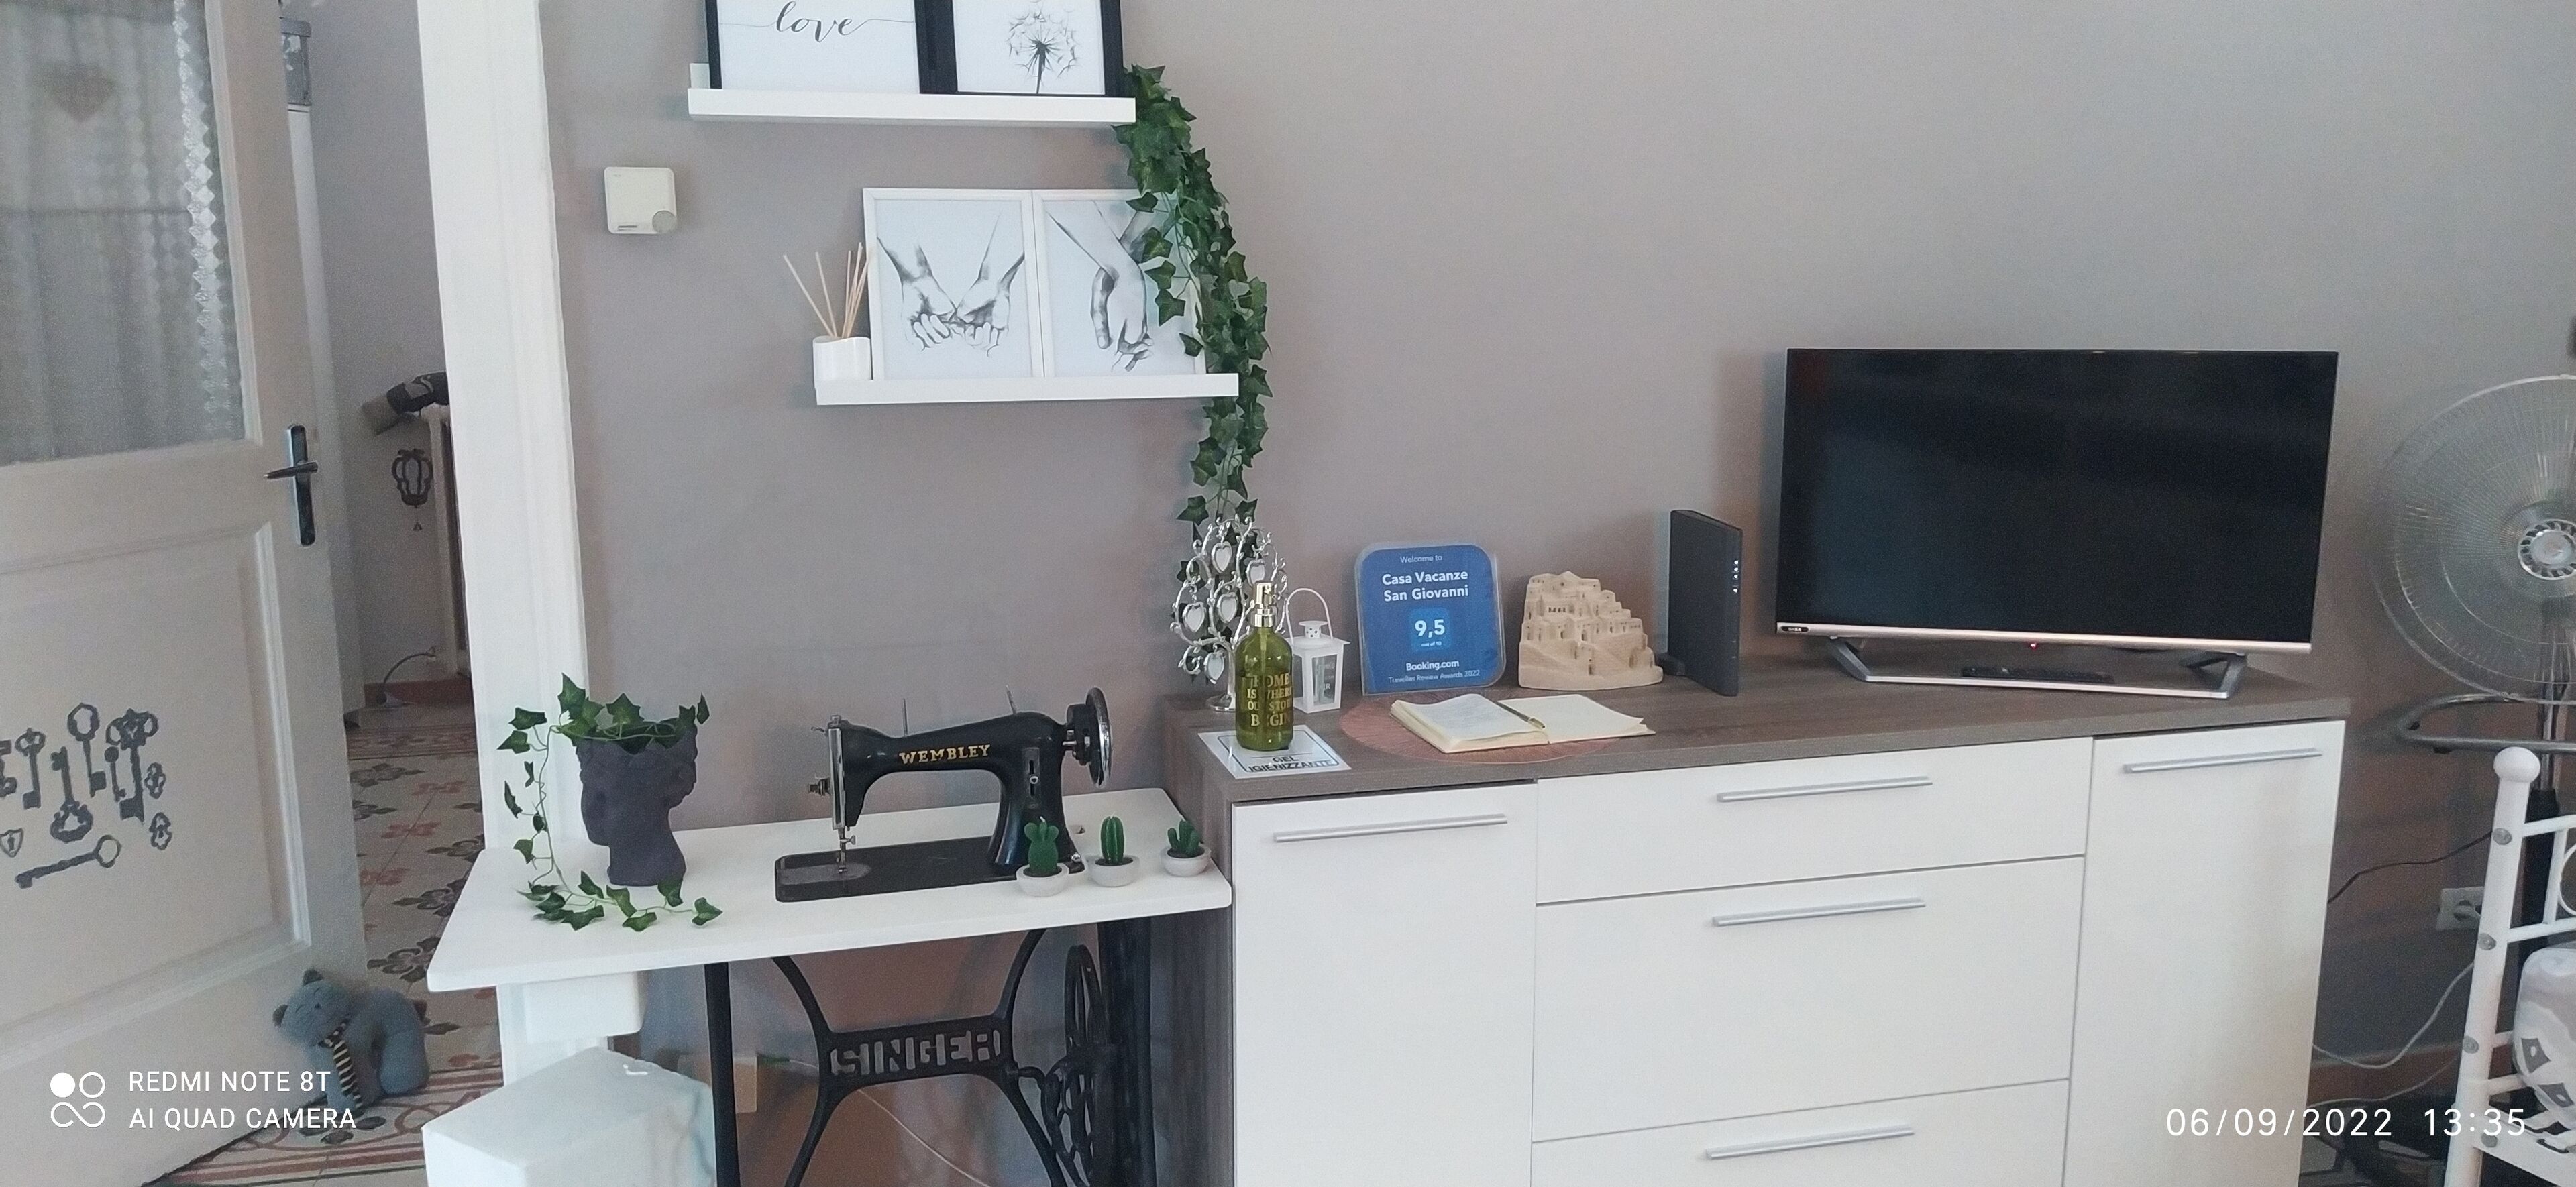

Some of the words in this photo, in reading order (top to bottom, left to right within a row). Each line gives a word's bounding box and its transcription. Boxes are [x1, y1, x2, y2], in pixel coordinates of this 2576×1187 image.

[774, 1, 871, 42] love
[1400, 555, 1434, 563] Welcome
[1382, 573, 1413, 585] Casa
[1414, 571, 1469, 583] Vacanze
[1383, 589, 1407, 602] San
[1411, 584, 1469, 600] Giovanni
[1414, 619, 1446, 638] 9,5
[1405, 660, 1460, 671] Booking.com
[1389, 675, 1415, 683] Traveller
[1440, 671, 1463, 679] Awards
[1464, 669, 1481, 677] 2022
[1247, 688, 1257, 699] IS
[899, 744, 990, 765] WEMBLEY
[1248, 760, 1332, 772] IGIENIZZANTE
[830, 1030, 1002, 1076] SINGER
